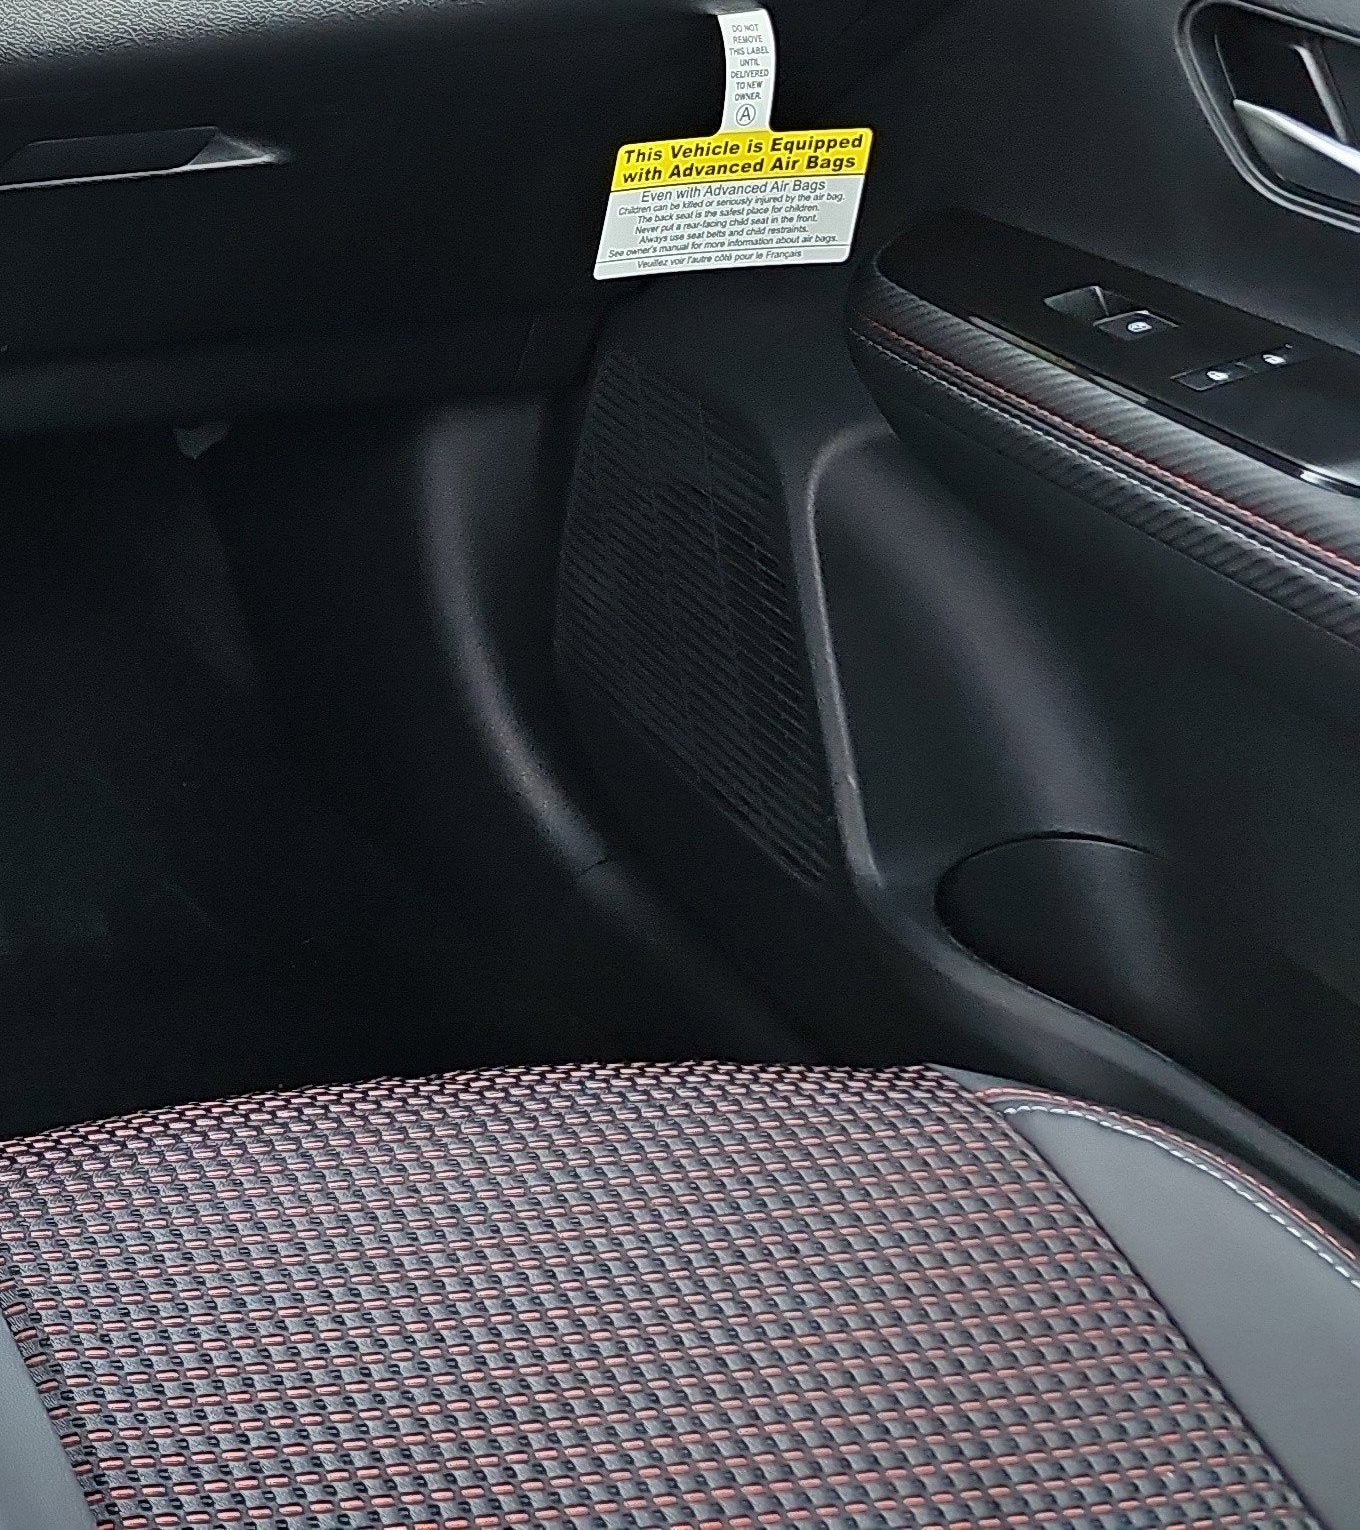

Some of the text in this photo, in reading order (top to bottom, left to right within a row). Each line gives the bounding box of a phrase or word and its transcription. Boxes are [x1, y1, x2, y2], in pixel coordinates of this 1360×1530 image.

[732, 24, 759, 33] DO NOT
[733, 35, 764, 44] REMOVE
[729, 46, 769, 57] THIS LABEL
[740, 58, 761, 67] UNTIL
[730, 69, 769, 79] DELIVERED
[736, 81, 763, 90] TO NEW
[625, 134, 864, 165] This Vehicle is Equipped
[623, 154, 856, 184] with Advanced Air Bags
[641, 179, 826, 202] Even with Advanced Air Bags
[618, 205, 651, 215] Children
[653, 204, 668, 212] can
[670, 203, 680, 211] be
[682, 200, 703, 209] killed
[716, 197, 753, 207] seriously
[755, 195, 783, 205] injured
[785, 194, 796, 203] by
[798, 193, 810, 202] the
[826, 192, 845, 202] bag.
[638, 215, 652, 224] The
[654, 213, 674, 222] back
[675, 211, 693, 220] seat
[694, 210, 702, 218] is
[719, 208, 744, 217] safest
[746, 206, 769, 216] place
[771, 205, 783, 214] for
[784, 204, 820, 213] children.
[635, 226, 659, 235] Never
[660, 224, 674, 234] put
[683, 219, 727, 230] rear-facing
[729, 218, 749, 226] child
[751, 217, 769, 225] seat
[771, 216, 779, 224] in
[781, 215, 794, 223] the
[796, 214, 818, 222] front.
[639, 225, 808, 244] Always use seat belts and child restraints.
[608, 234, 838, 258] See owner's manual for more information about air bags.
